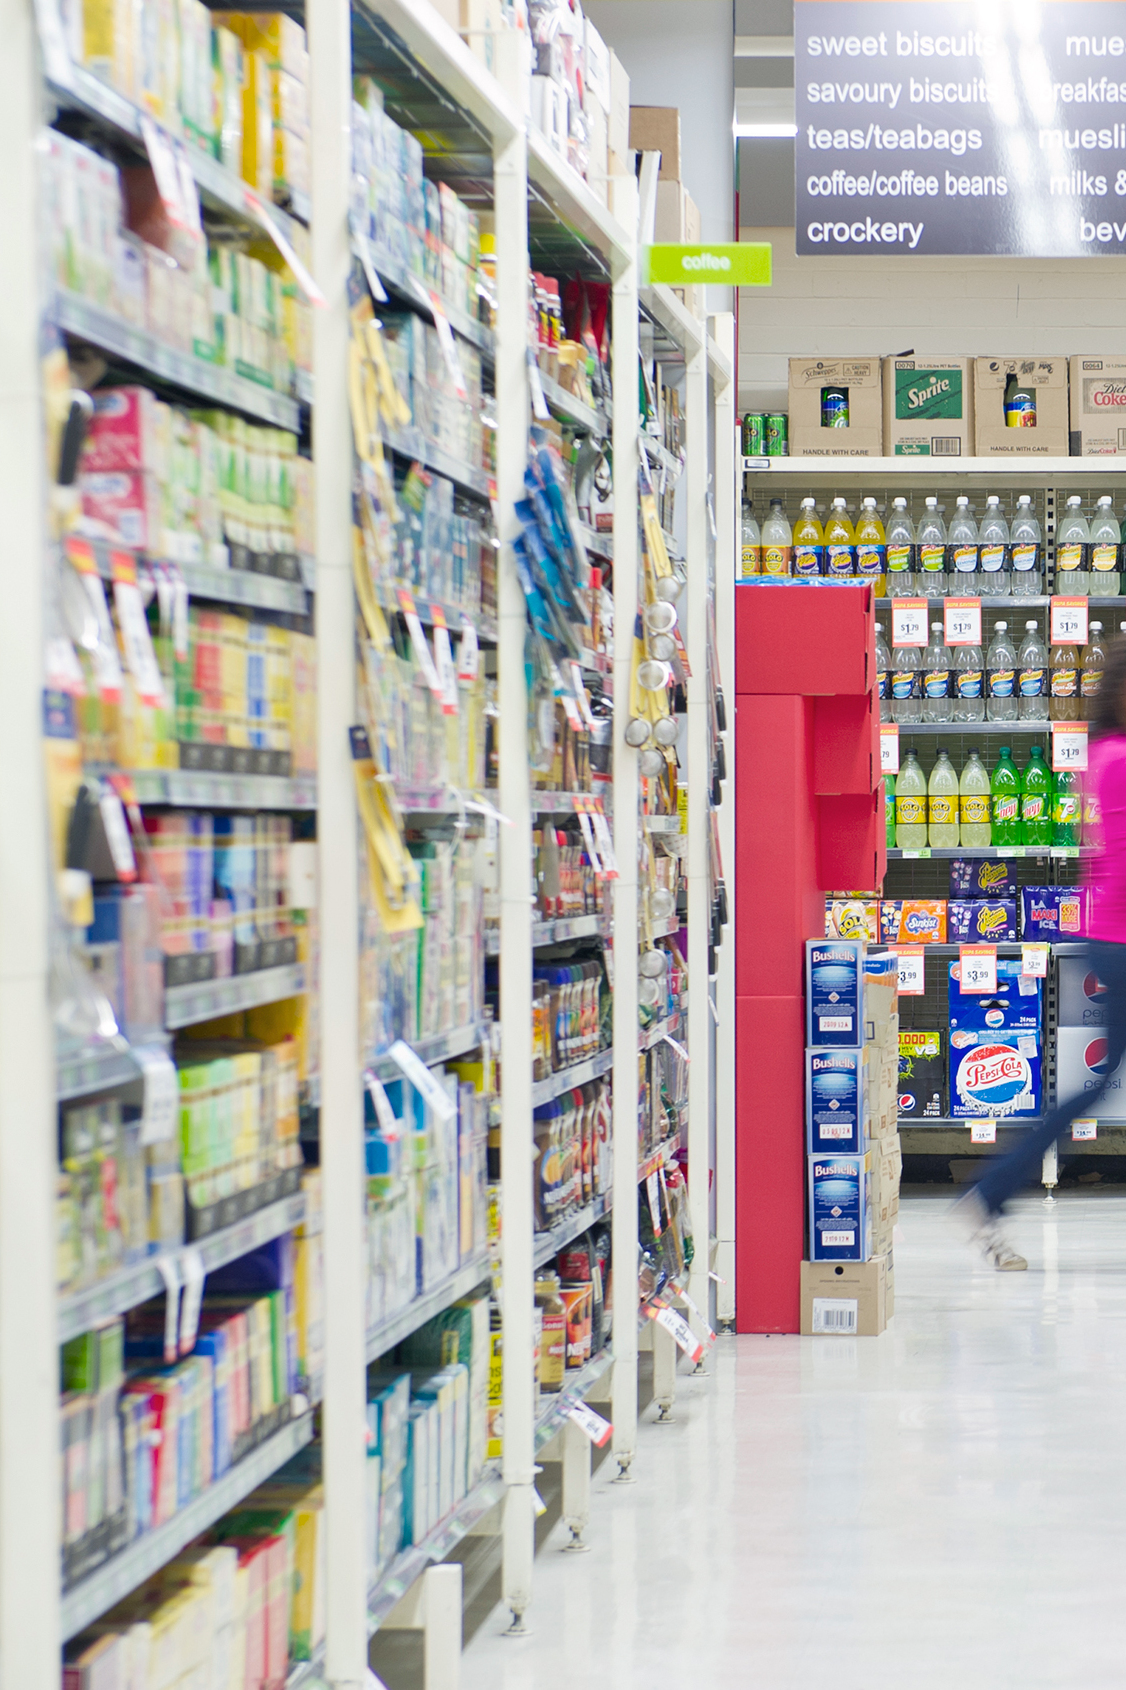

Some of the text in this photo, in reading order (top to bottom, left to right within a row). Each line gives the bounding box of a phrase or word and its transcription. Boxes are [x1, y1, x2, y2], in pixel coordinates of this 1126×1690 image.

[807, 30, 996, 56] sweet biscuits
[807, 77, 995, 109] savoury biscuits
[807, 123, 982, 156] teas/teabags
[1039, 123, 1126, 149] muesli
[807, 169, 1008, 196] coffee/coffee beans
[1050, 170, 1108, 196] milks
[807, 216, 924, 249] crockery
[681, 252, 732, 271] coffee
[805, 367, 836, 379] Schweppes
[908, 376, 950, 409] Sprite
[1103, 382, 1126, 394] Diet
[902, 445, 921, 454] Sprite
[900, 803, 919, 811] SOLO
[931, 803, 949, 811] SOLO
[965, 803, 984, 811] SOLO
[1031, 899, 1046, 909] LA
[1031, 909, 1058, 921] MAXI
[839, 915, 868, 934] SOLO
[908, 917, 938, 929] Sunkist
[1039, 920, 1058, 930] ICE
[812, 951, 856, 963] Bushells
[967, 971, 989, 981] $3.99
[914, 1044, 938, 1056] V8
[812, 1058, 856, 1070] Bushells
[814, 1165, 858, 1177] Bushells
